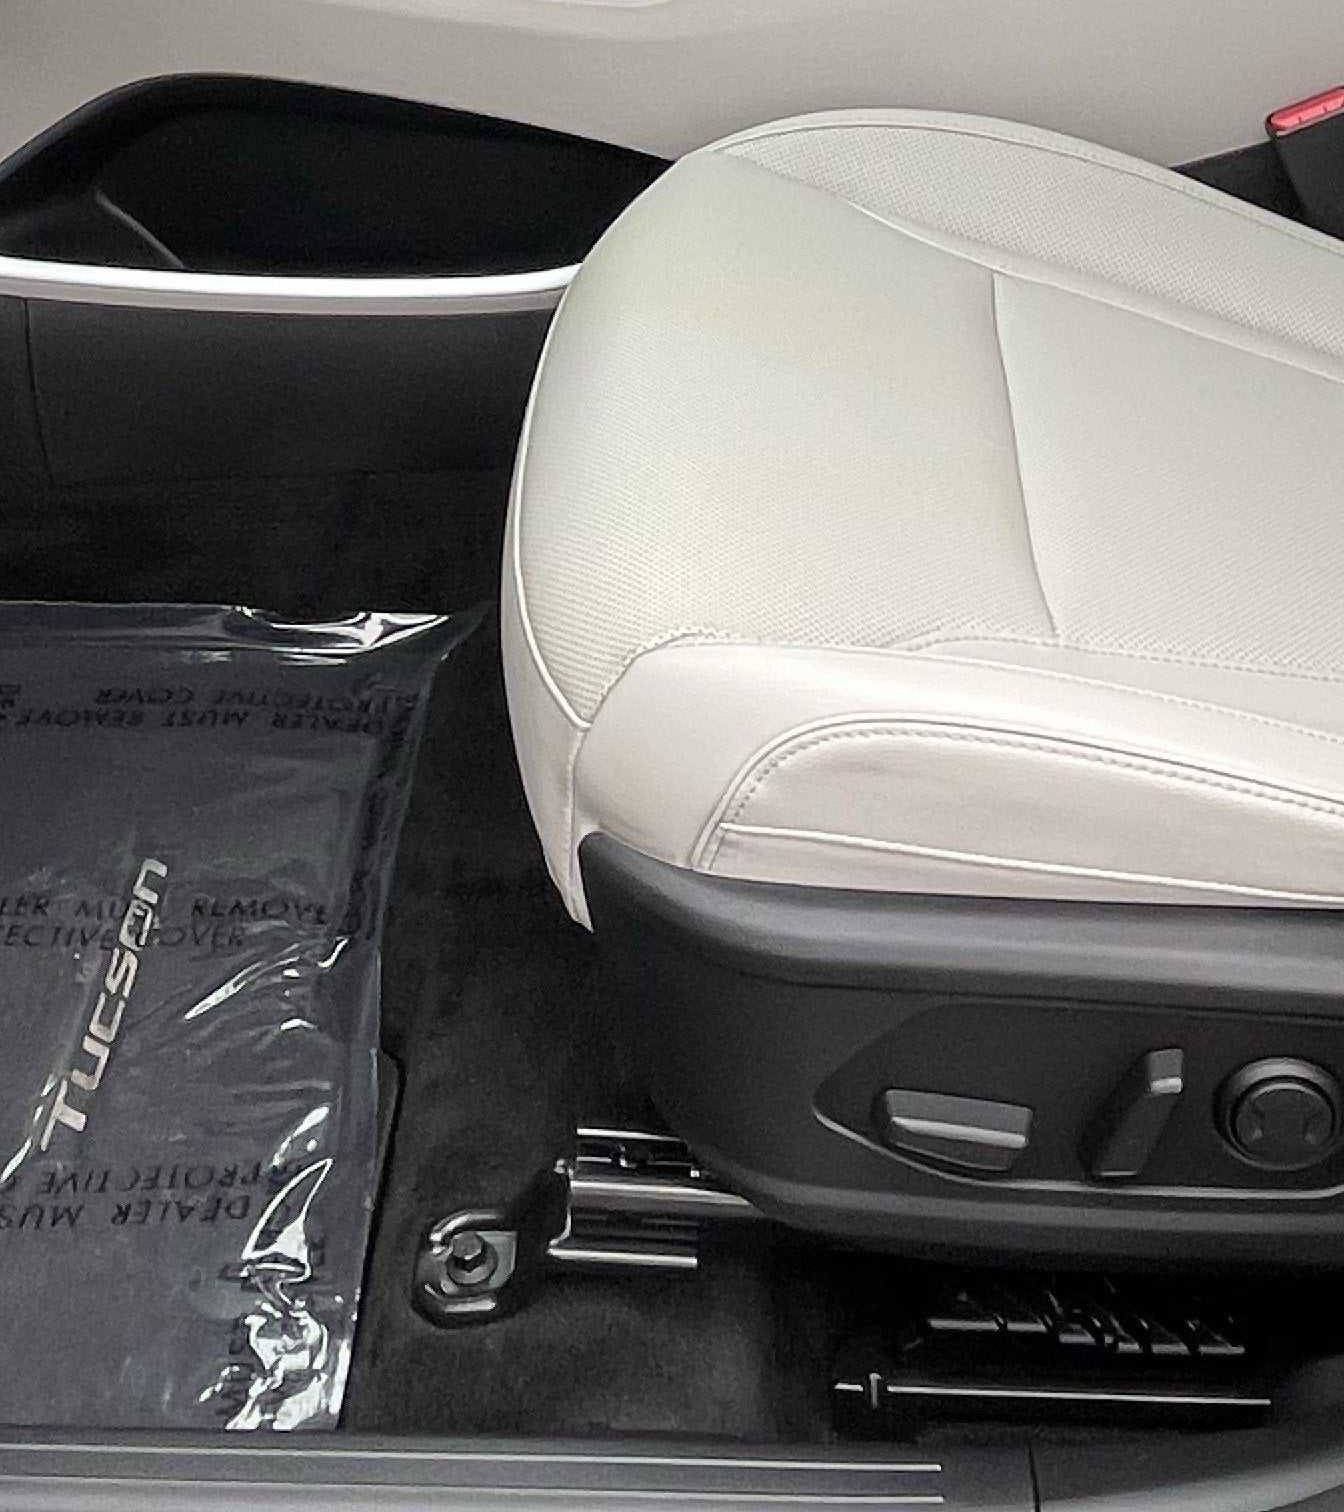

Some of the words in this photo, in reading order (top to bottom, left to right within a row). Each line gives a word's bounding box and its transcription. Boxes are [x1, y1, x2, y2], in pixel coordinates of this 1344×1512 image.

[92, 687, 195, 706] COVER
[17, 708, 145, 729] REMOVE
[161, 708, 251, 728] MUST
[273, 709, 384, 736] DEALER
[152, 925, 247, 950] OVER
[43, 1162, 261, 1195] PROTECTIVE
[110, 1195, 252, 1226] DEALER
